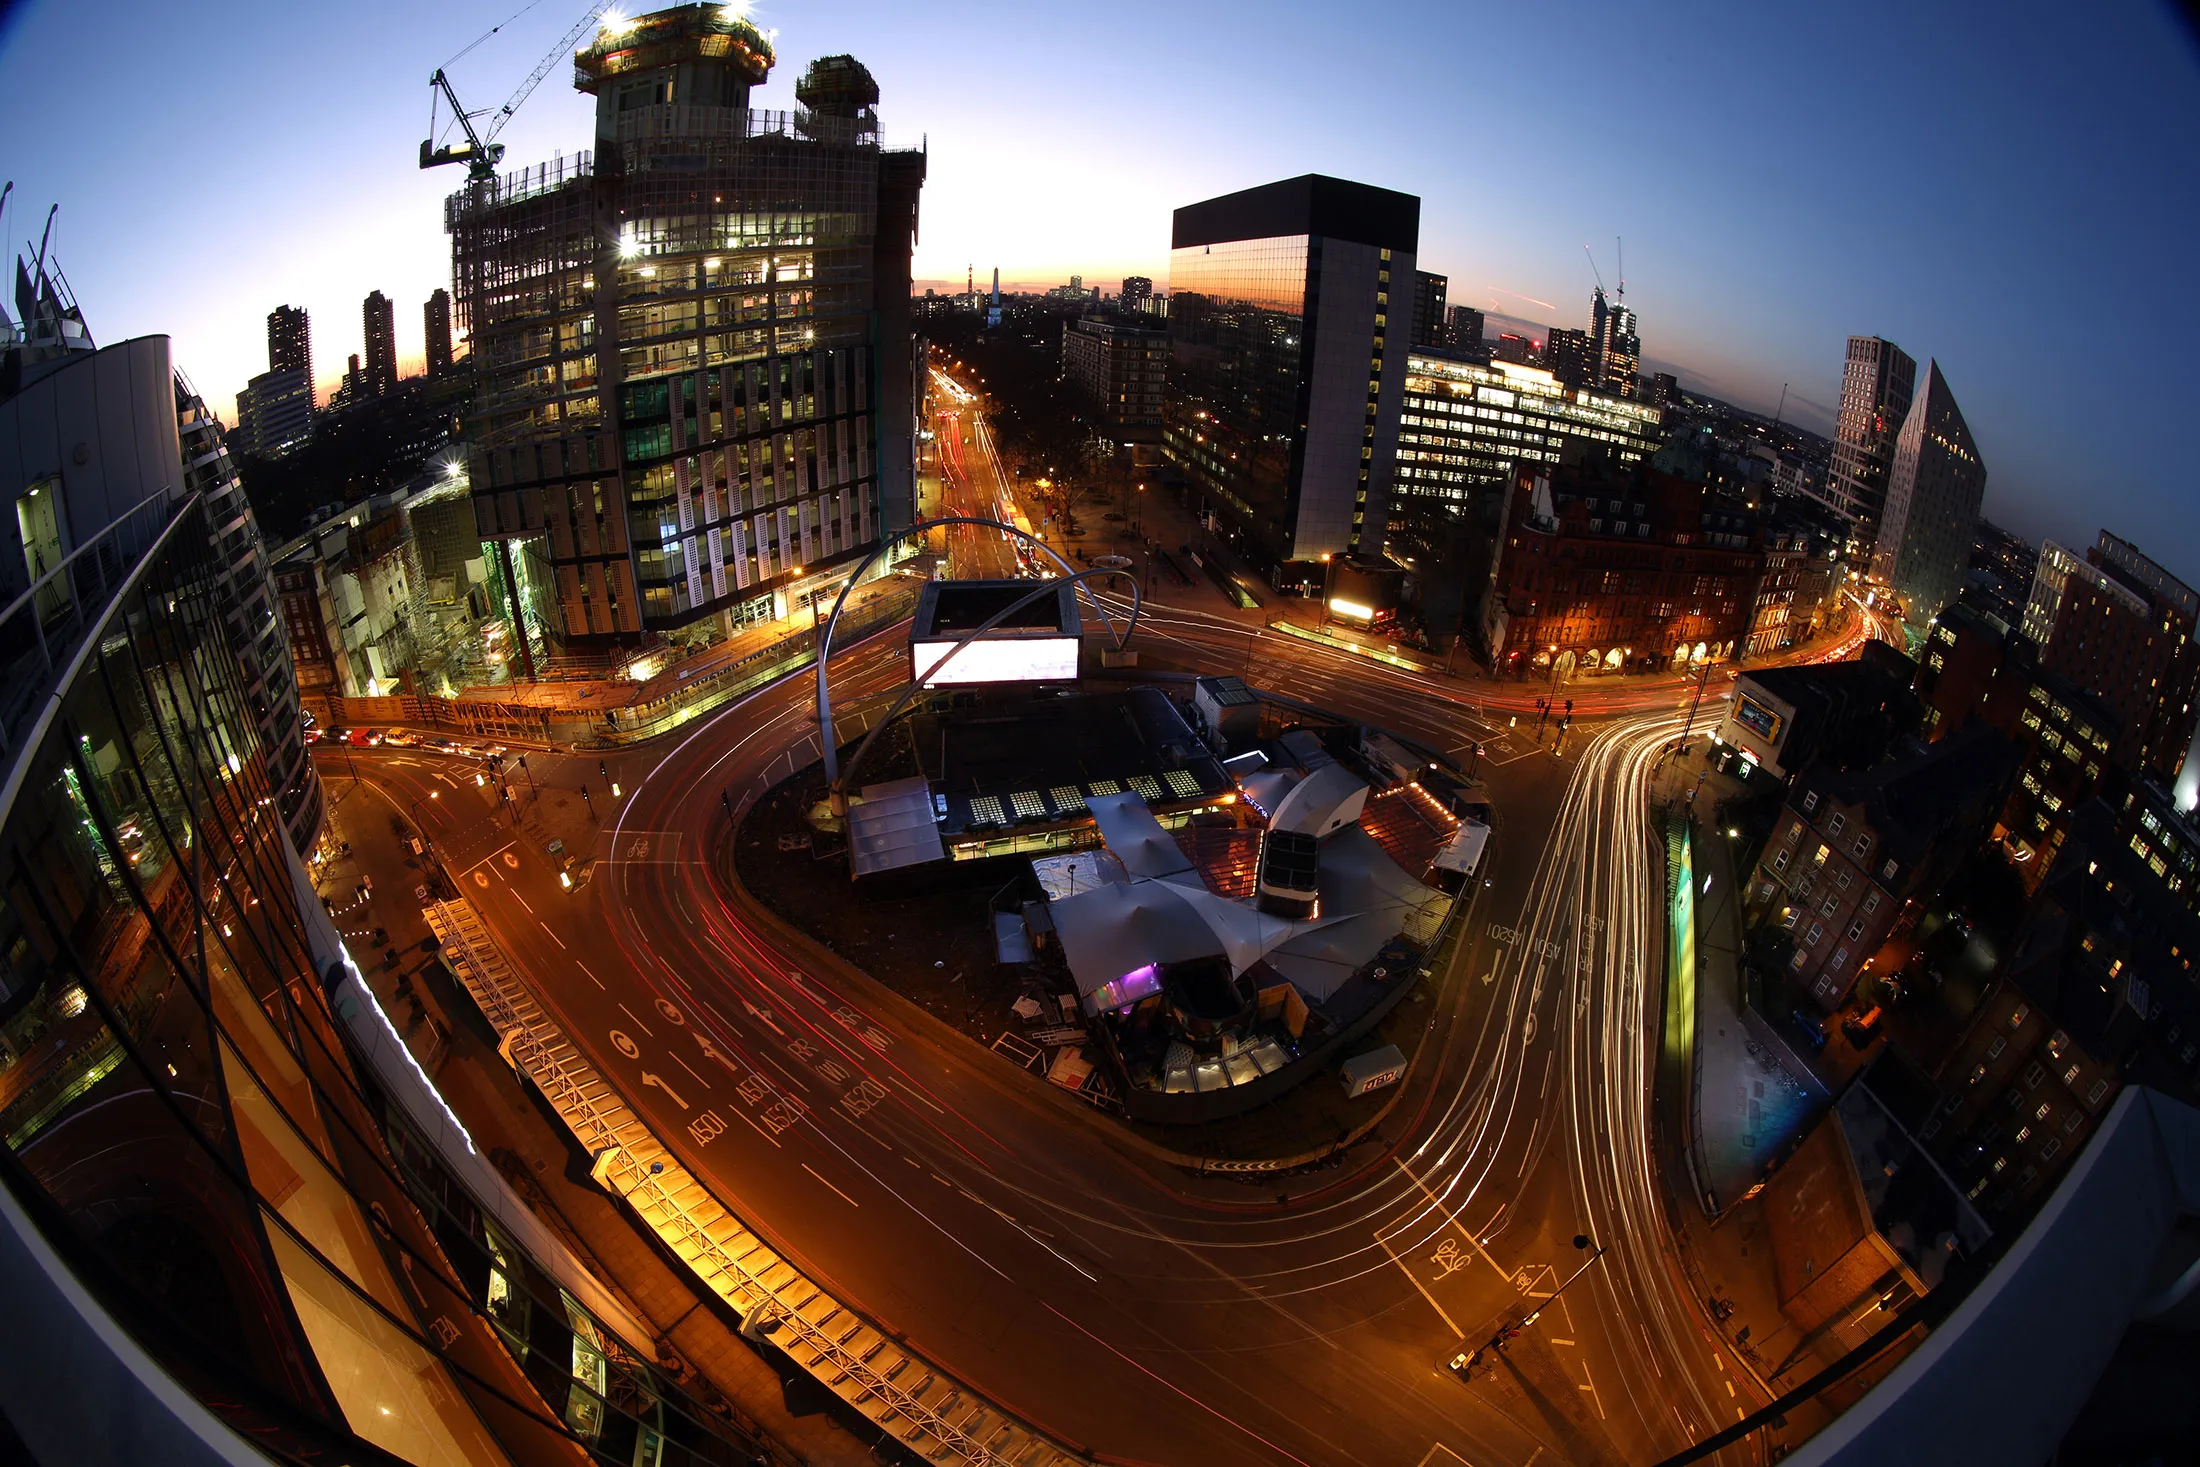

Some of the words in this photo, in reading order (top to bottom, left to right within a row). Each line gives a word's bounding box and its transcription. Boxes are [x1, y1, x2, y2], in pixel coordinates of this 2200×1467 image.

[1487, 922, 1523, 946] A5201
[1533, 937, 1561, 960] A501
[736, 1072, 777, 1107] A501
[840, 1075, 891, 1118] A5201
[688, 1109, 728, 1147] A501
[761, 1092, 810, 1135] A5201
